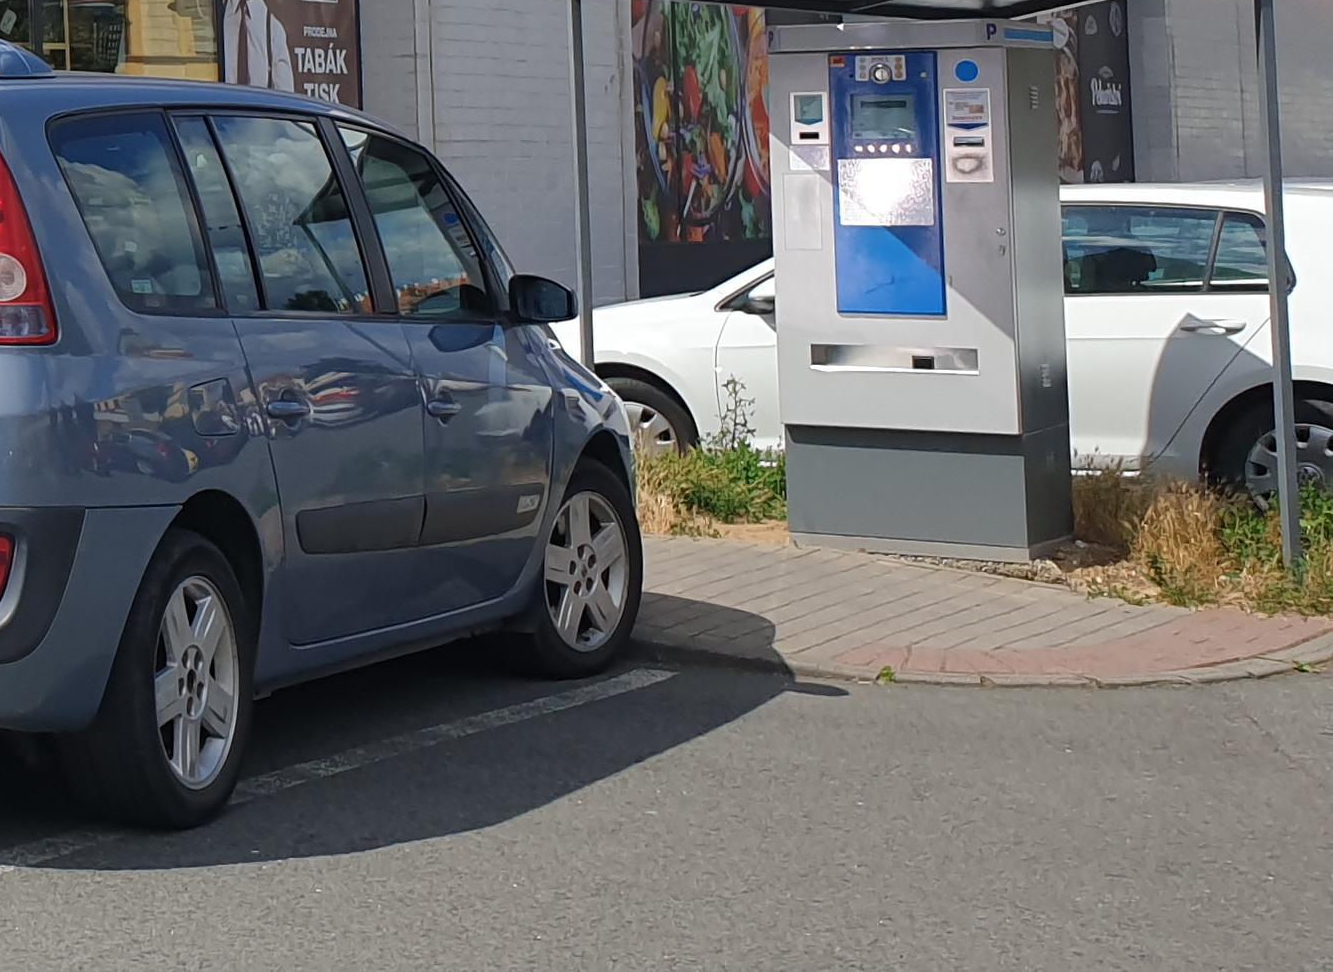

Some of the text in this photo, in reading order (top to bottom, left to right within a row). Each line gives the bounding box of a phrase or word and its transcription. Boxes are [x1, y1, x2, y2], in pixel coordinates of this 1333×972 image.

[303, 26, 338, 39] PRODEJNA
[986, 23, 997, 40] P
[294, 42, 348, 74] TABÁK
[303, 82, 341, 104] TISK
